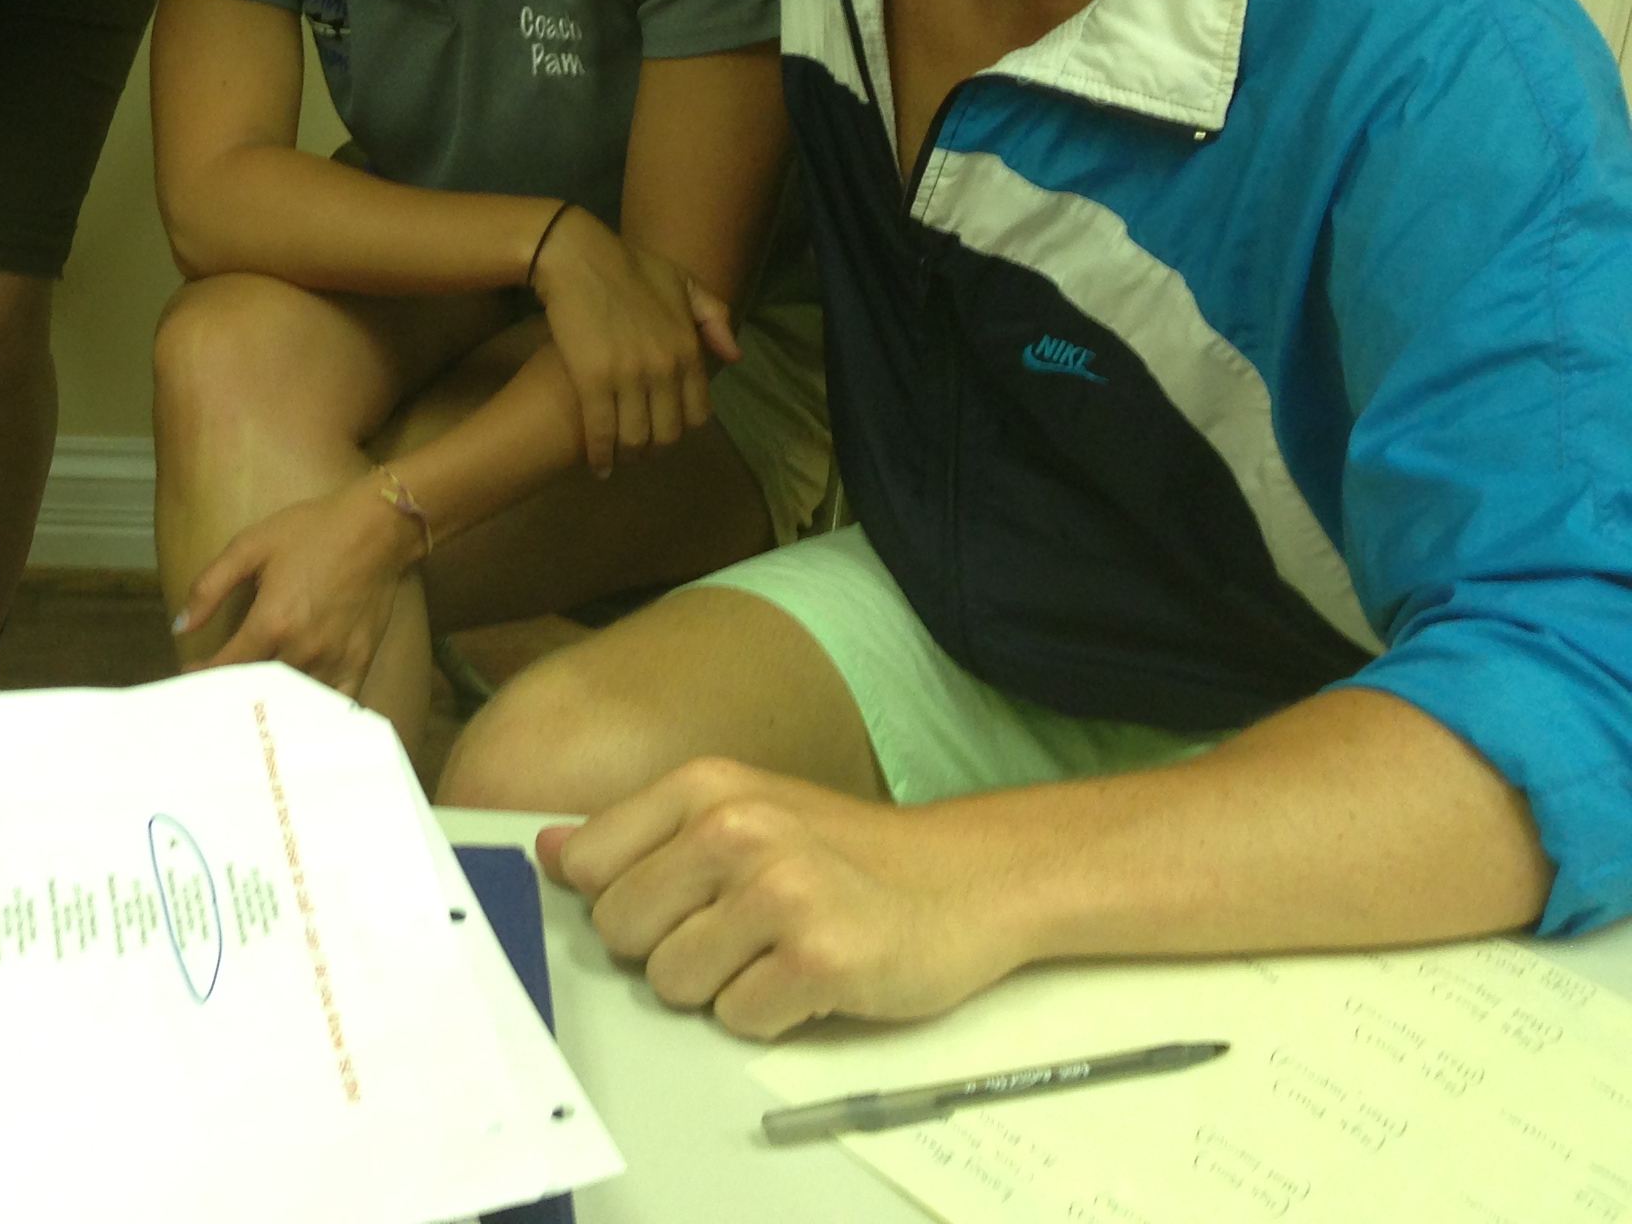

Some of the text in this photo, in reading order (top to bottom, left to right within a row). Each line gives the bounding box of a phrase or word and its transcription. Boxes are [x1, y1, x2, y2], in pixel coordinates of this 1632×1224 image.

[520, 5, 583, 42] Coach
[530, 42, 586, 78] Pam
[1034, 333, 1097, 370] NIKE
